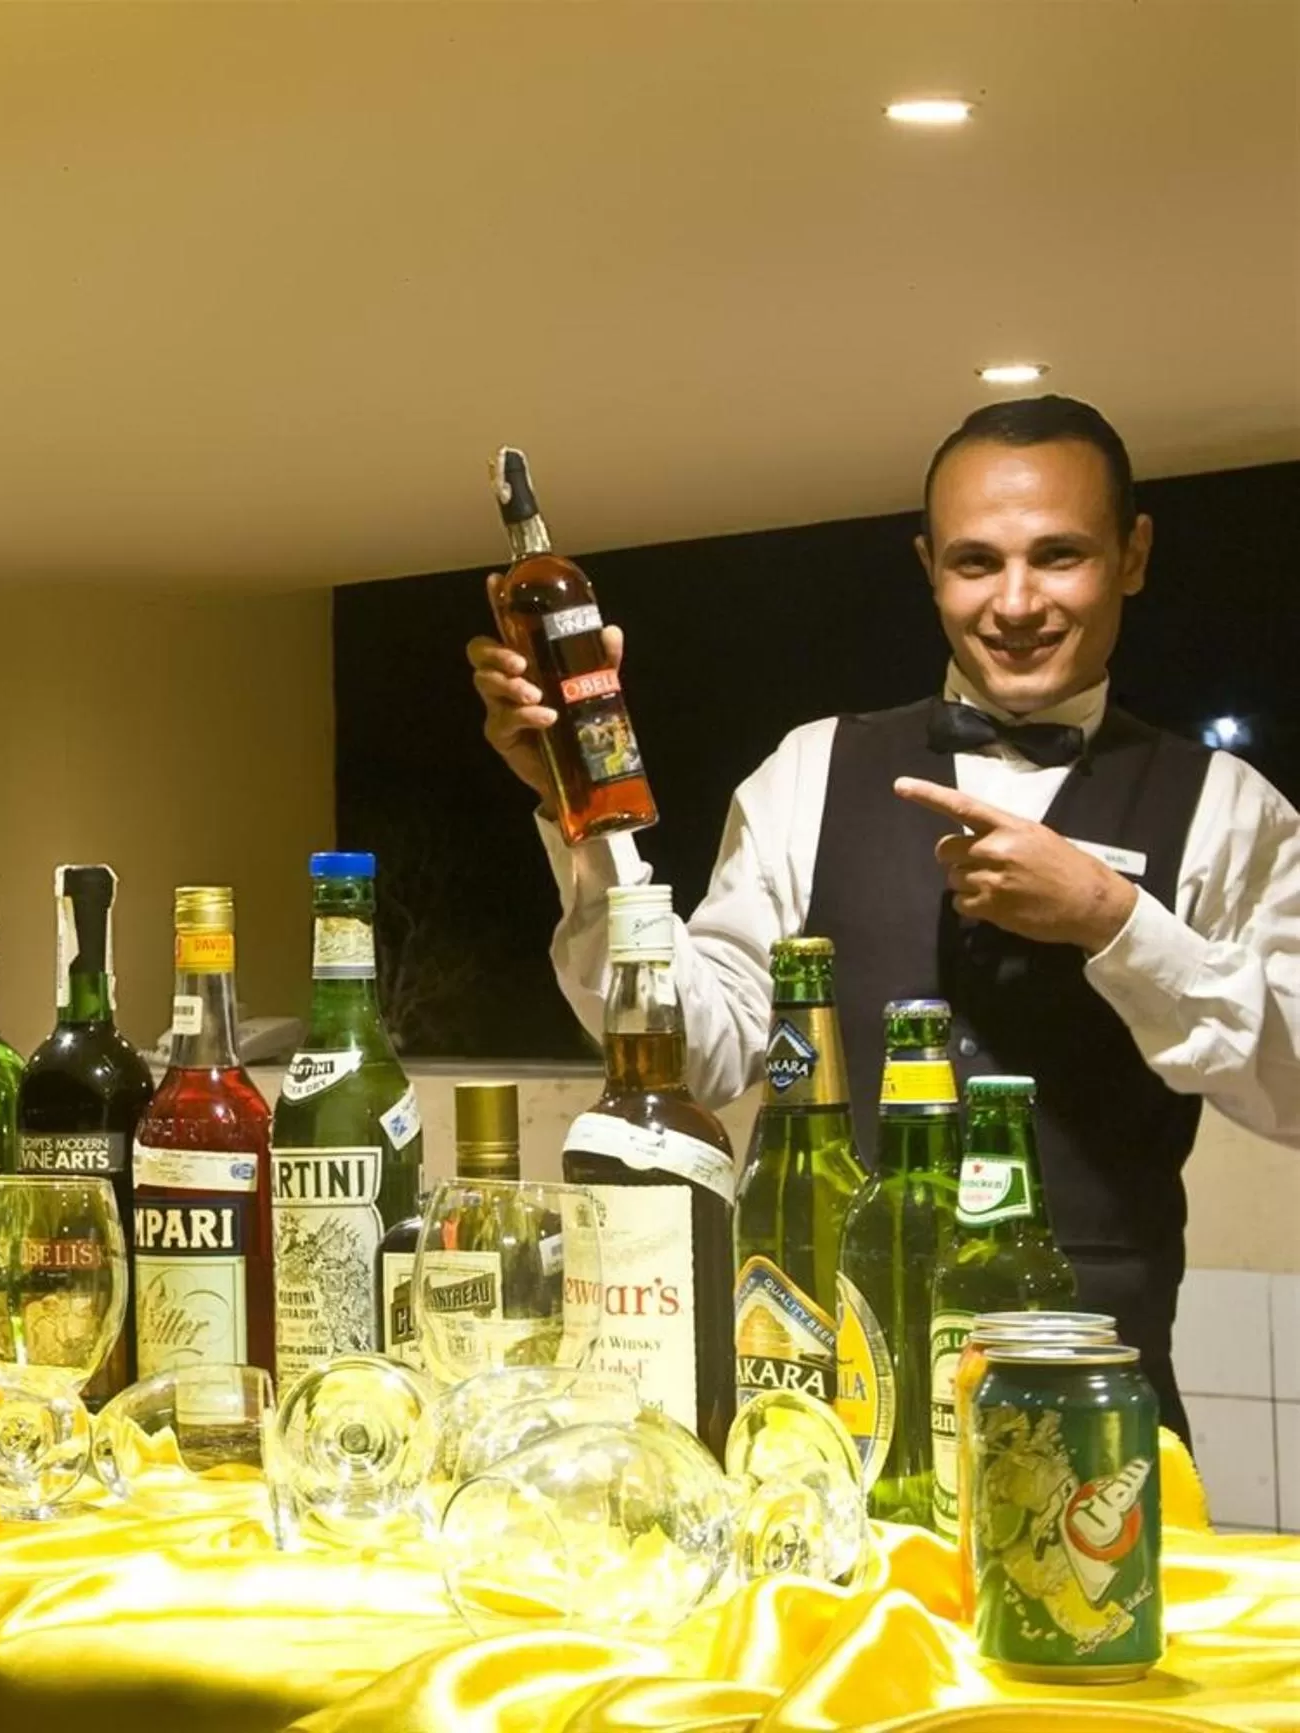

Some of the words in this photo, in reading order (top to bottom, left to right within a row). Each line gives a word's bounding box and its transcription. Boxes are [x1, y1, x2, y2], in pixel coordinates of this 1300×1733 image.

[766, 1059, 809, 1077] AKARA
[55, 1137, 110, 1151] MODERN
[272, 1160, 365, 1198] RTINI
[133, 1208, 234, 1248] MPARI
[564, 1277, 680, 1316] ewar's
[763, 1278, 808, 1321] QUALITY
[807, 1316, 837, 1346] BEER
[736, 1358, 828, 1399] AKARA
